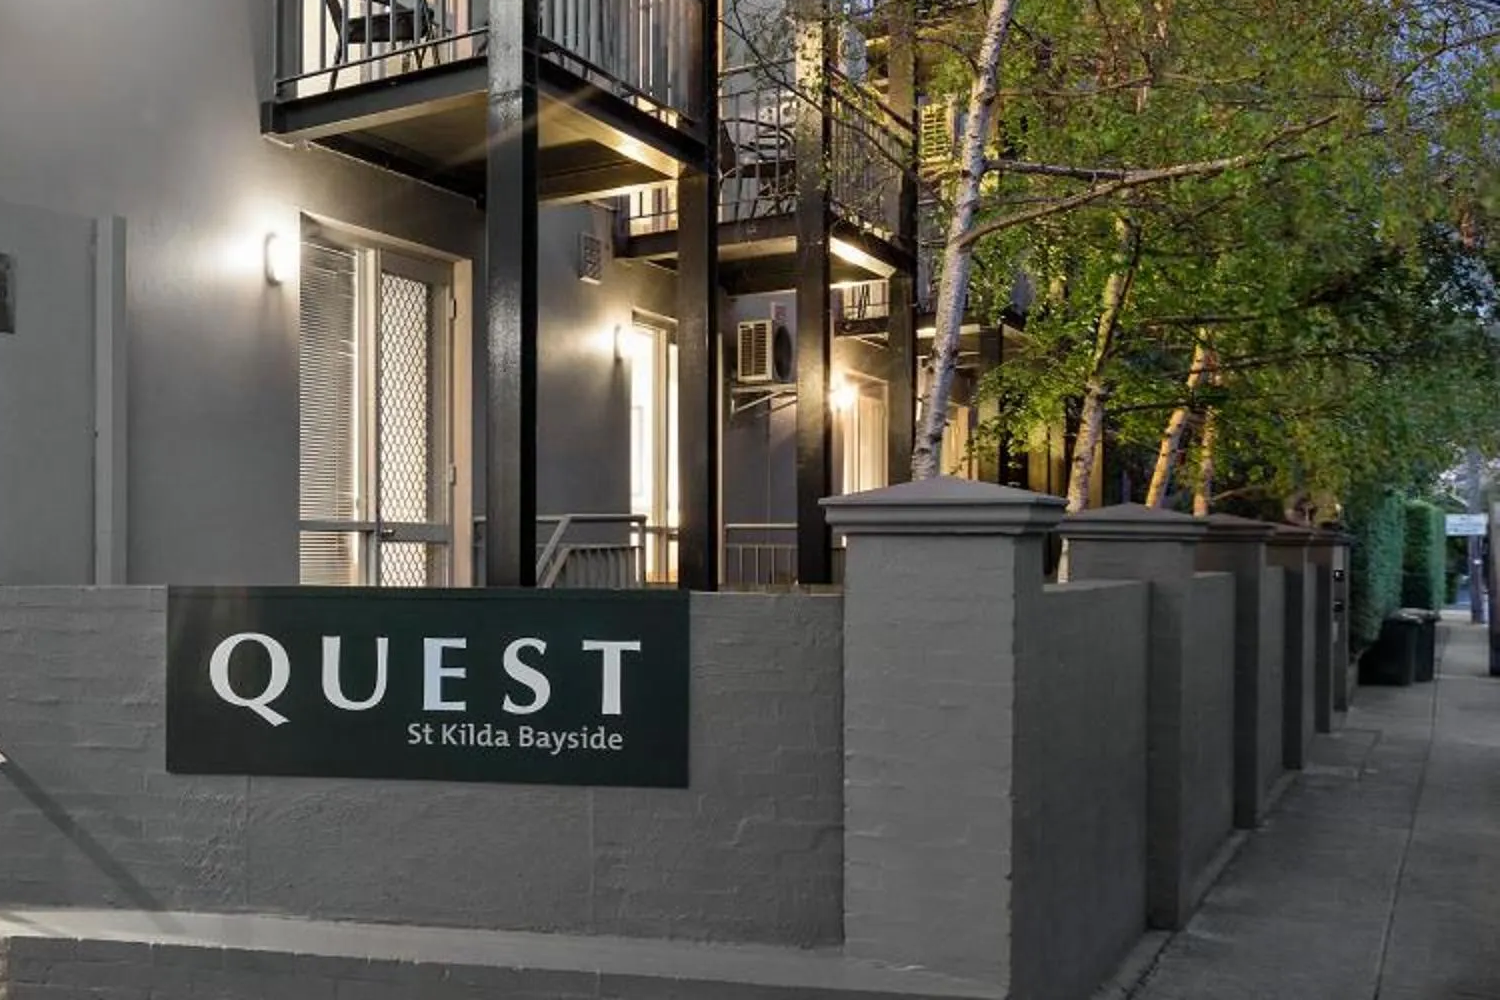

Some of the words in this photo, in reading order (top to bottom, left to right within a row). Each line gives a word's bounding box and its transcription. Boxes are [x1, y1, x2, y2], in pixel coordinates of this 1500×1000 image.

[208, 632, 642, 727] QUEST
[407, 723, 434, 745] St
[441, 724, 511, 748] Kilda
[518, 726, 624, 755] Bayside
